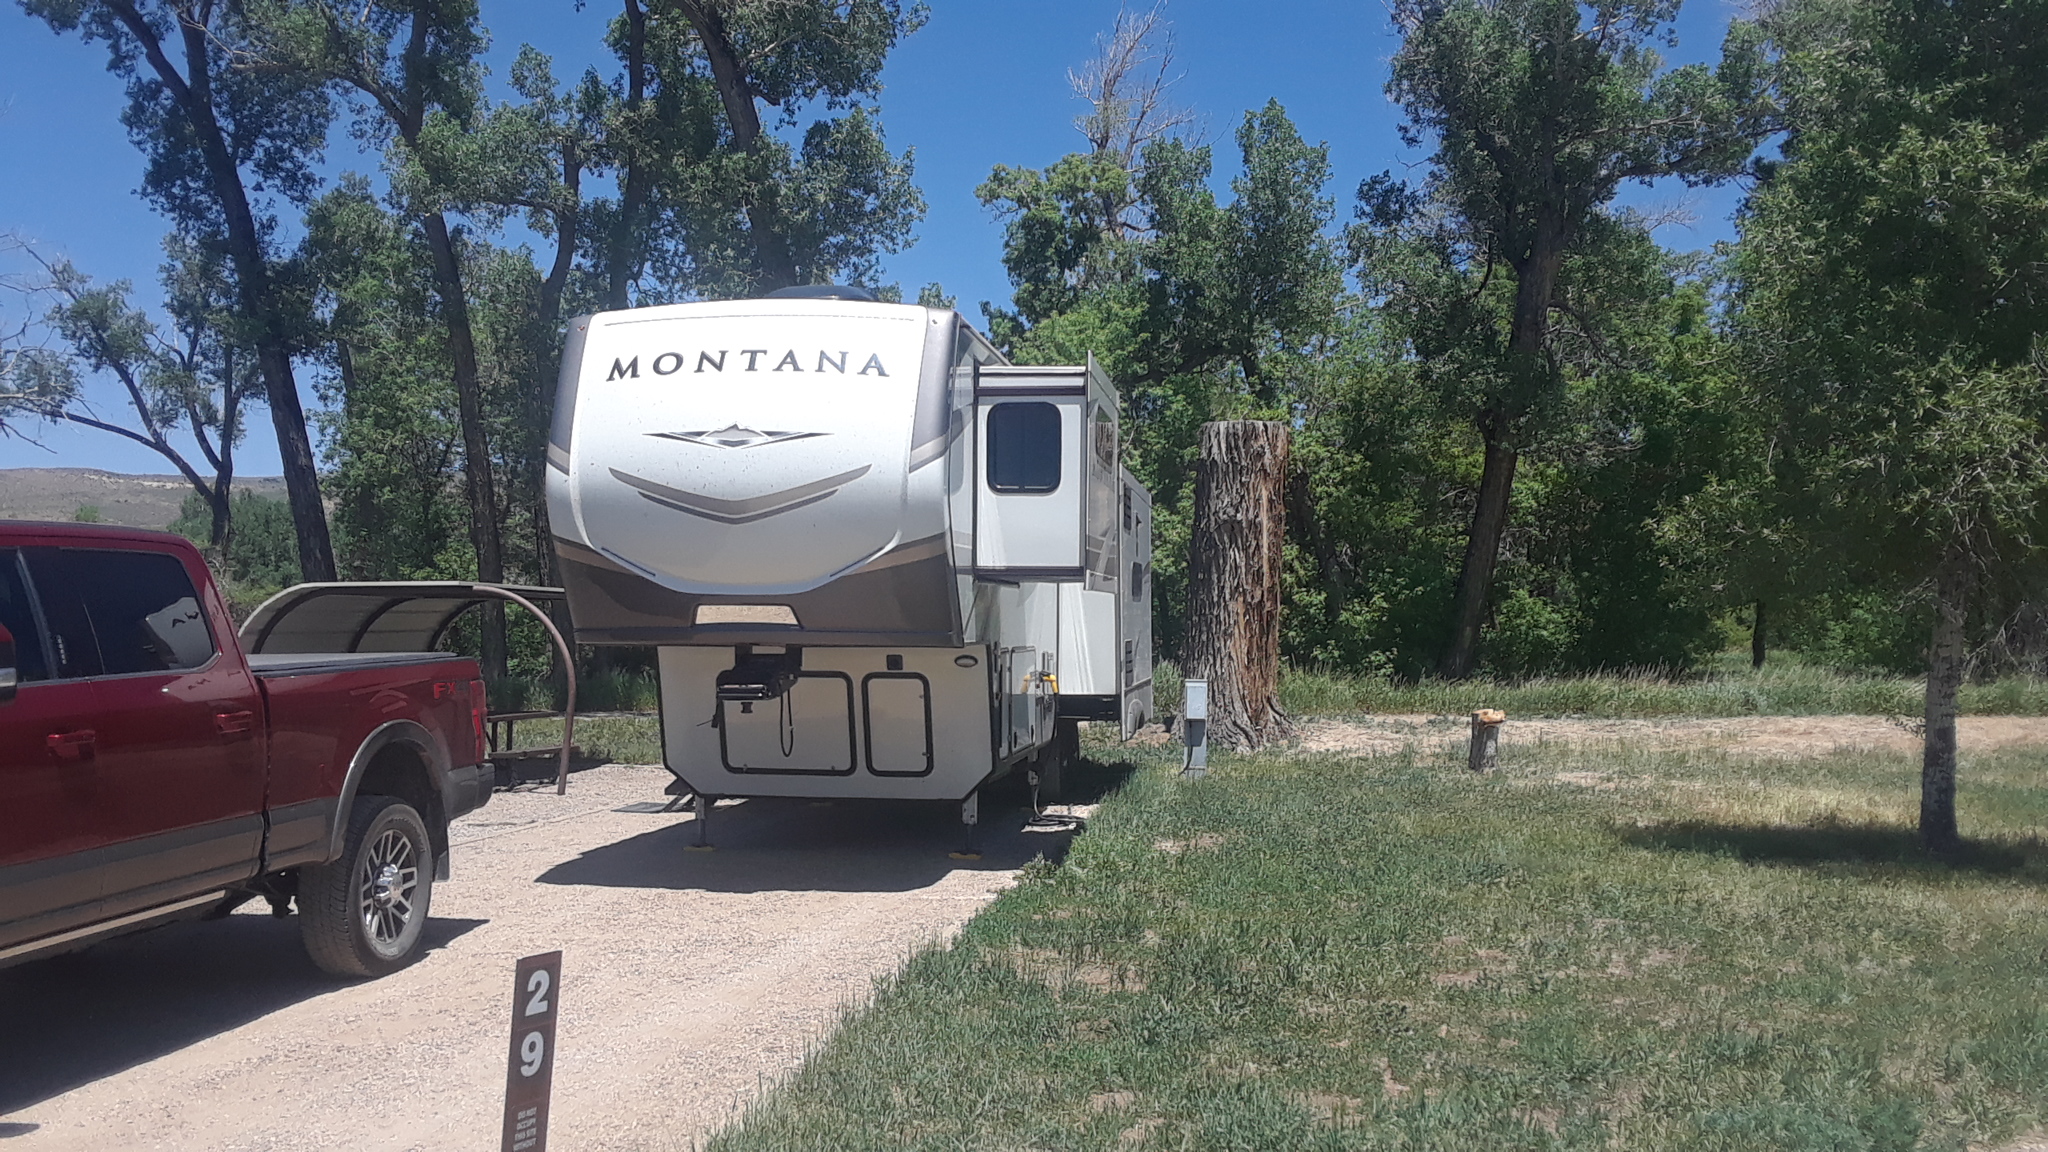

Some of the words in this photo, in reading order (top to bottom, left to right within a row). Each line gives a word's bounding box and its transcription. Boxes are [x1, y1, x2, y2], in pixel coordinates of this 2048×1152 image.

[606, 349, 890, 382] MONTANA
[525, 970, 550, 1017] 2
[520, 1031, 544, 1078] 9
